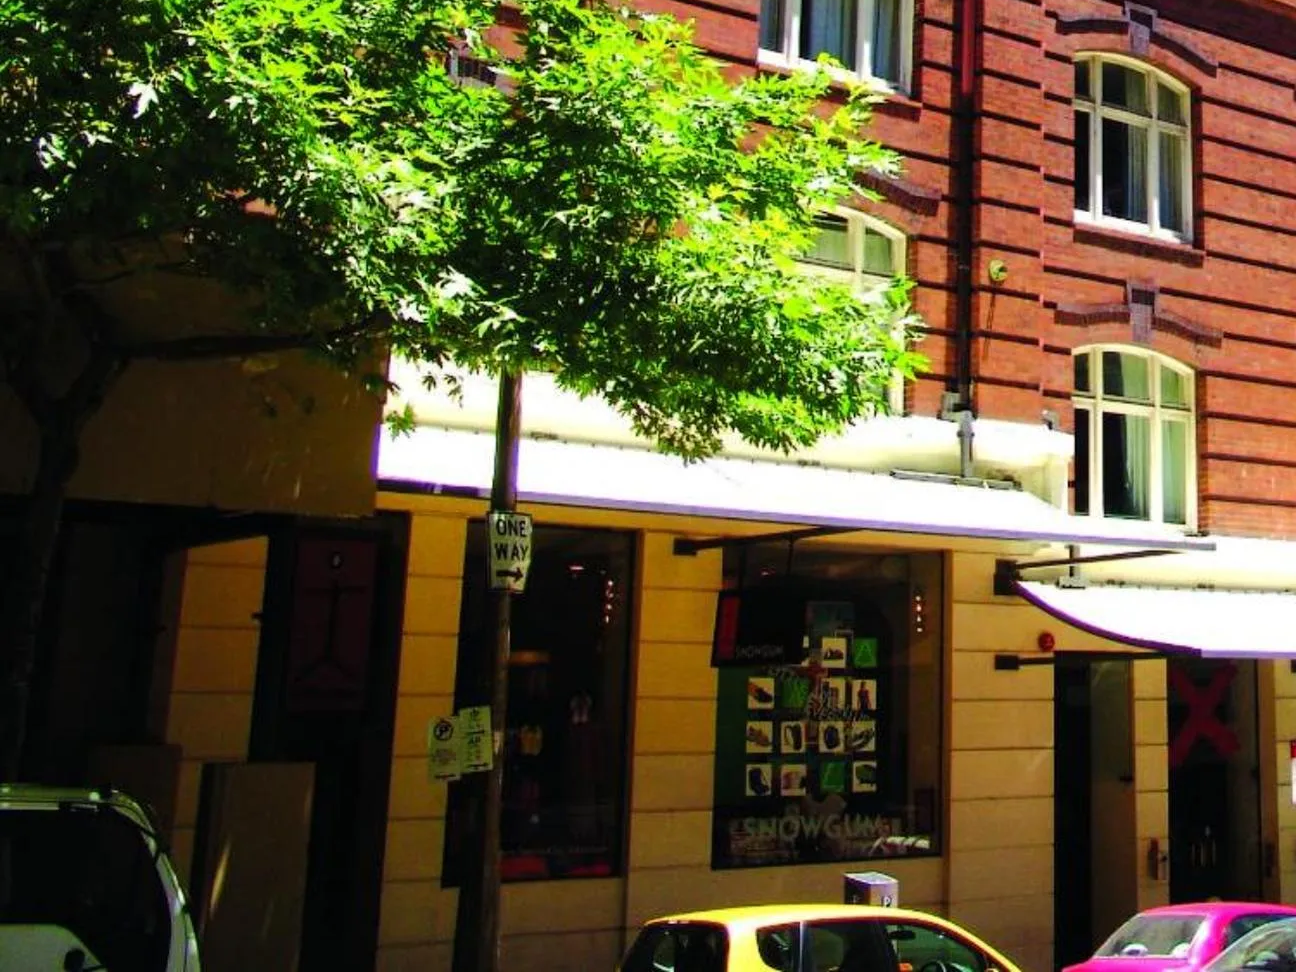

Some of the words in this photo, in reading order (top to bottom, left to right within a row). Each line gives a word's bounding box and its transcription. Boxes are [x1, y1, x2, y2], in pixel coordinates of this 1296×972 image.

[496, 518, 528, 537] ONE
[494, 543, 530, 562] WAY
[744, 813, 881, 841] SNOWGUM
